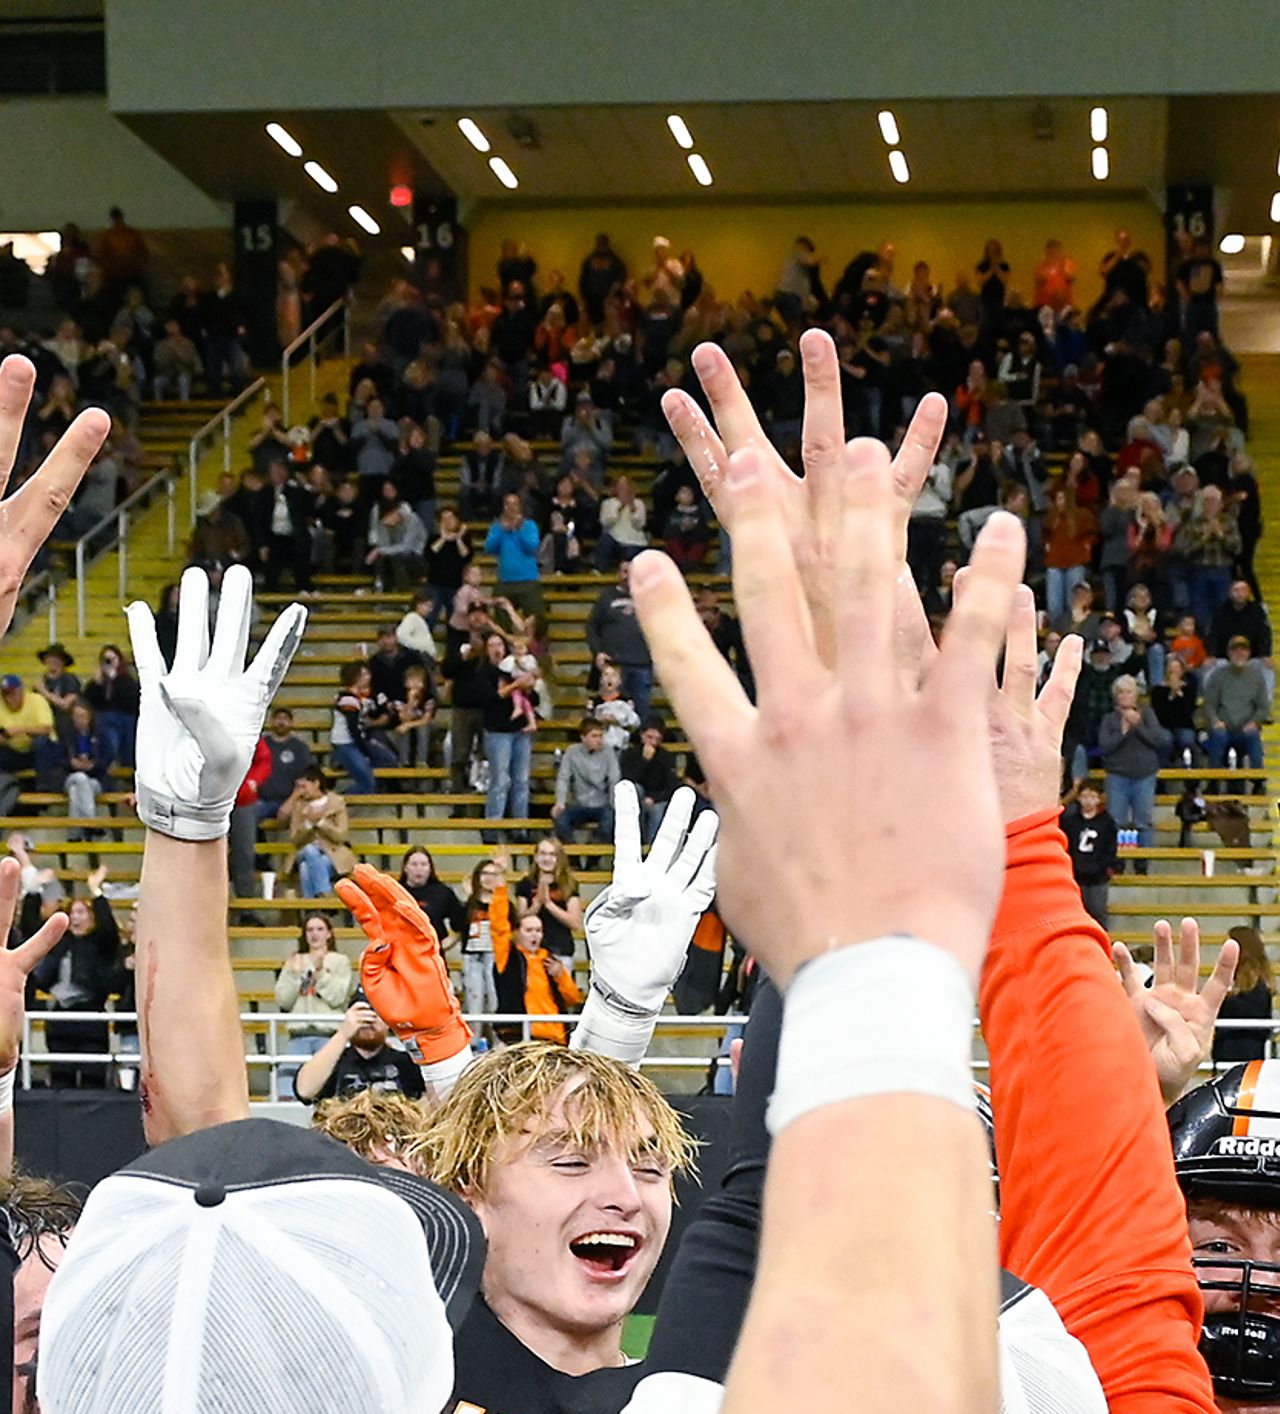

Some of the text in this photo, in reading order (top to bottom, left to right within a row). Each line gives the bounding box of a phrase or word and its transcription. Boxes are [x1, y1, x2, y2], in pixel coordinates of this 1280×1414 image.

[241, 224, 271, 250] 15
[418, 222, 455, 249] 16
[1173, 211, 1206, 237] 16
